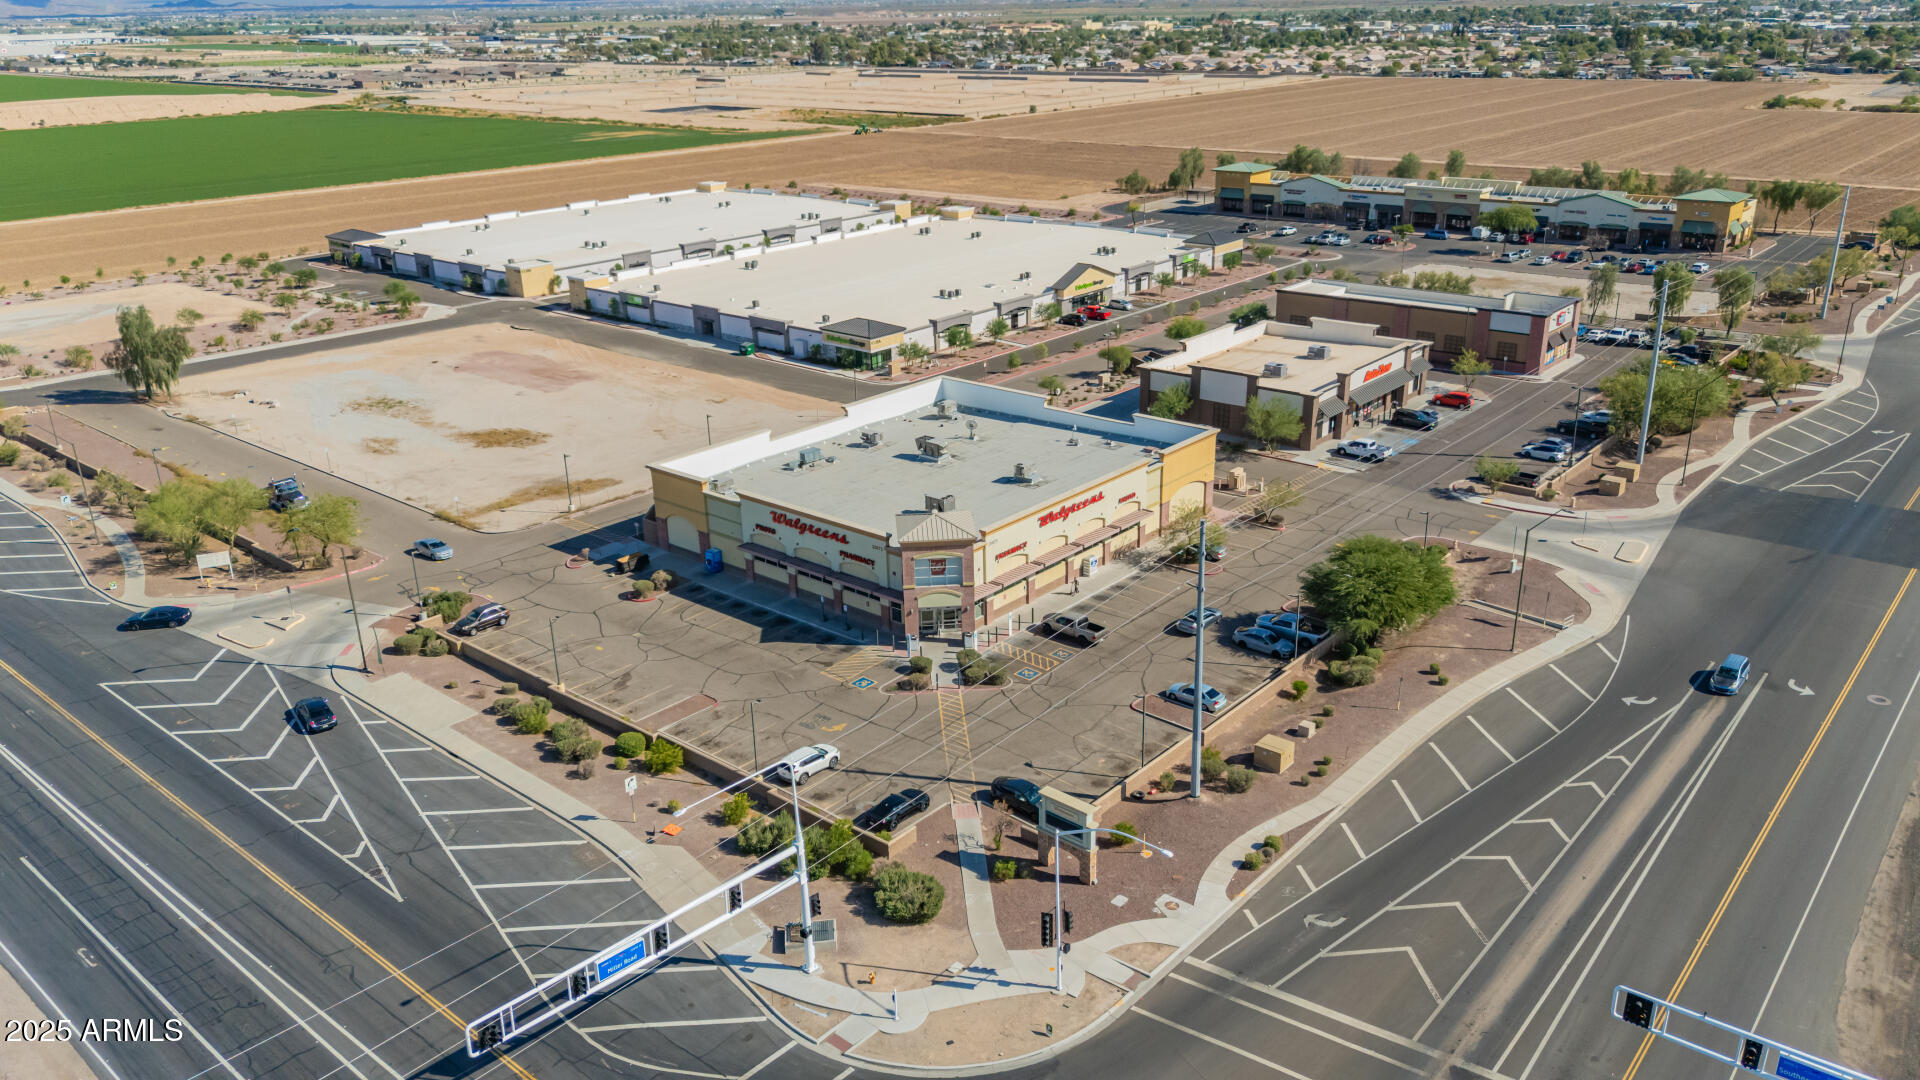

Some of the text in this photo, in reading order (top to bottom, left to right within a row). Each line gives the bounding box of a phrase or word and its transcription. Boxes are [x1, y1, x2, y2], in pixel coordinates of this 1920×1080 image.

[1038, 491, 1104, 528] Walgreens
[770, 511, 849, 545] Walgreens
[839, 550, 875, 566] PHARMACY
[623, 953, 638, 965] Road
